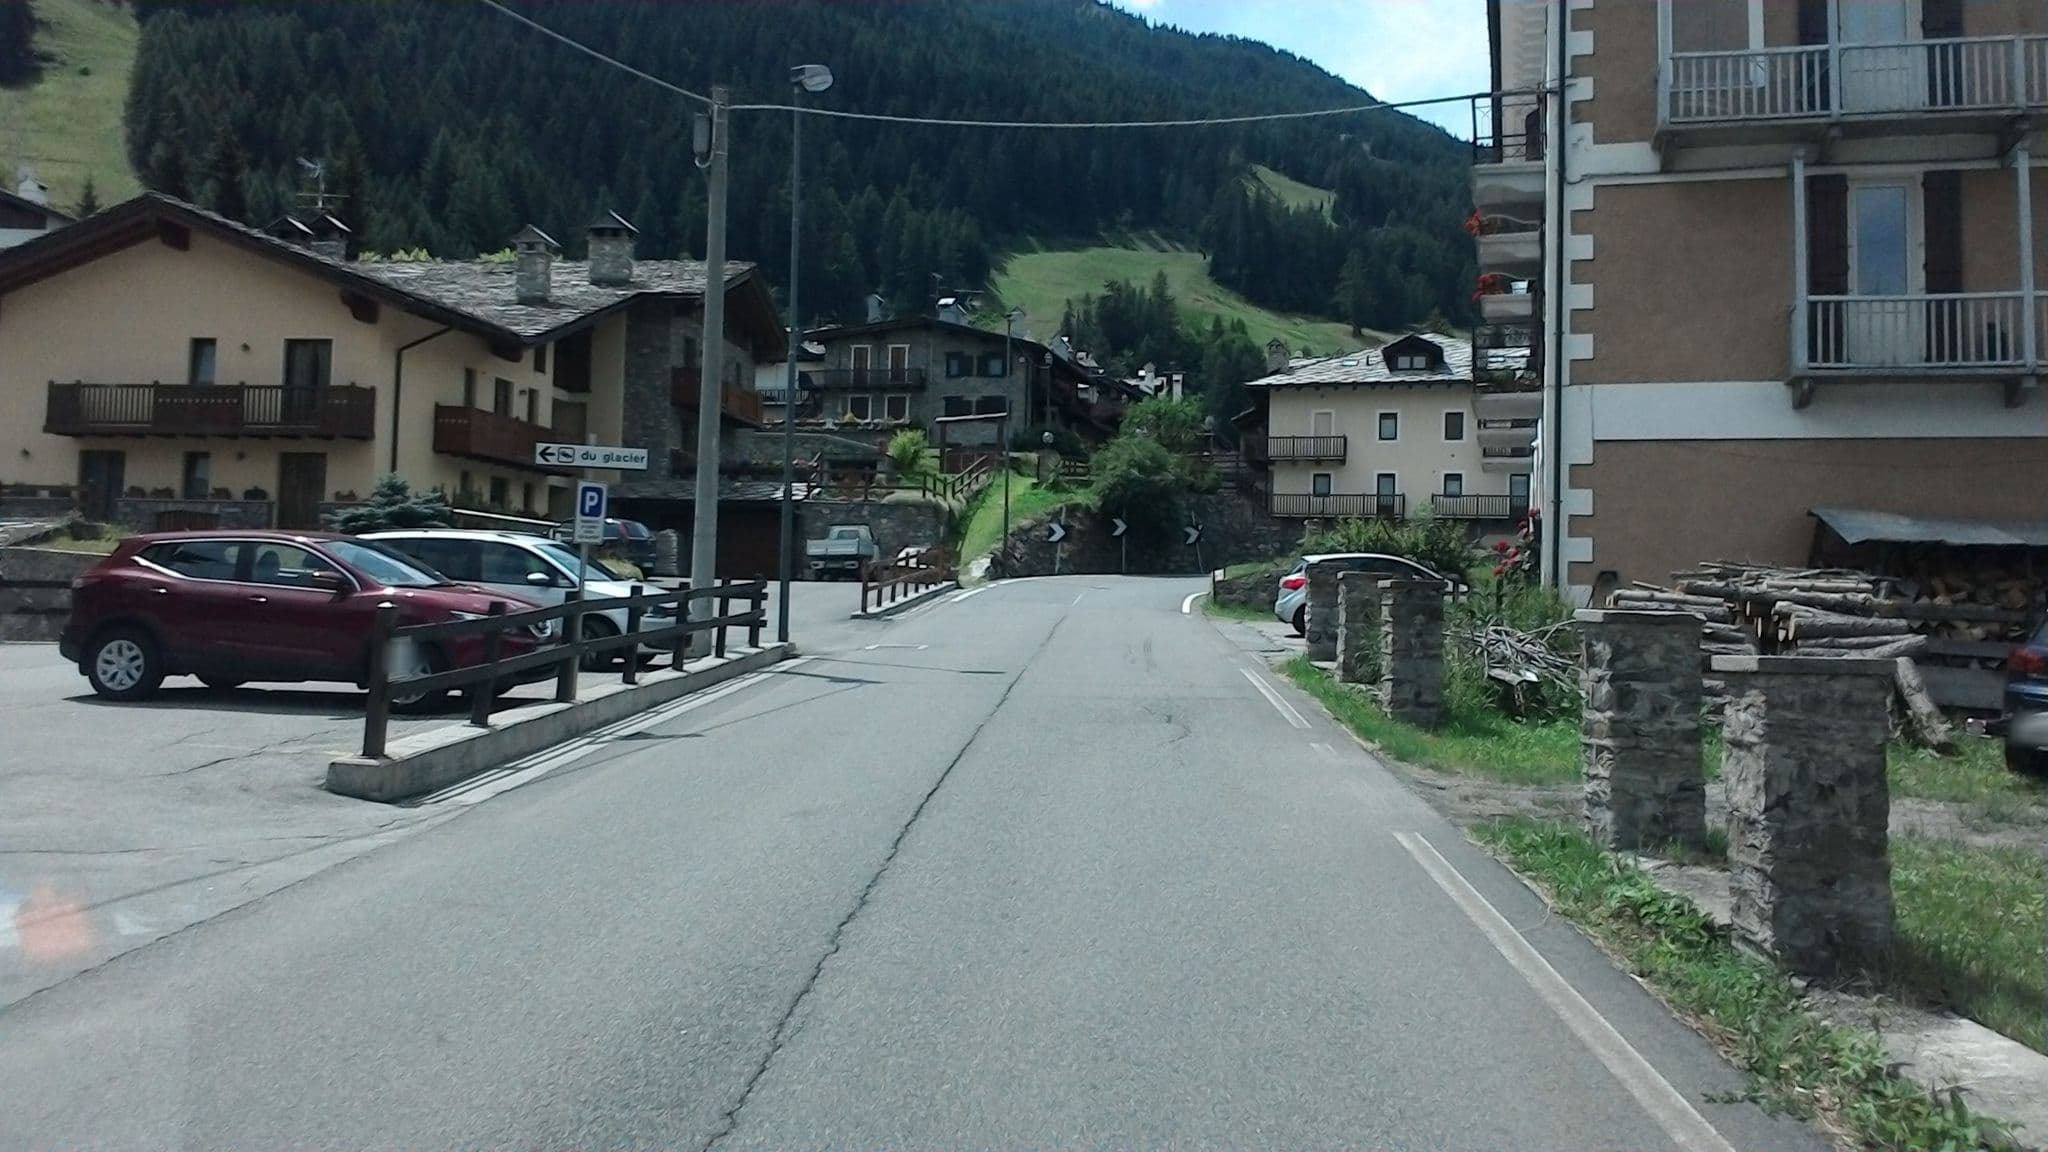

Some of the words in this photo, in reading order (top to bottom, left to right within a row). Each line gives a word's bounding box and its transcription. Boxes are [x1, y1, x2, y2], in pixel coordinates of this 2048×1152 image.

[581, 451, 597, 461] du
[603, 452, 646, 464] glacier
[585, 491, 599, 513] P
